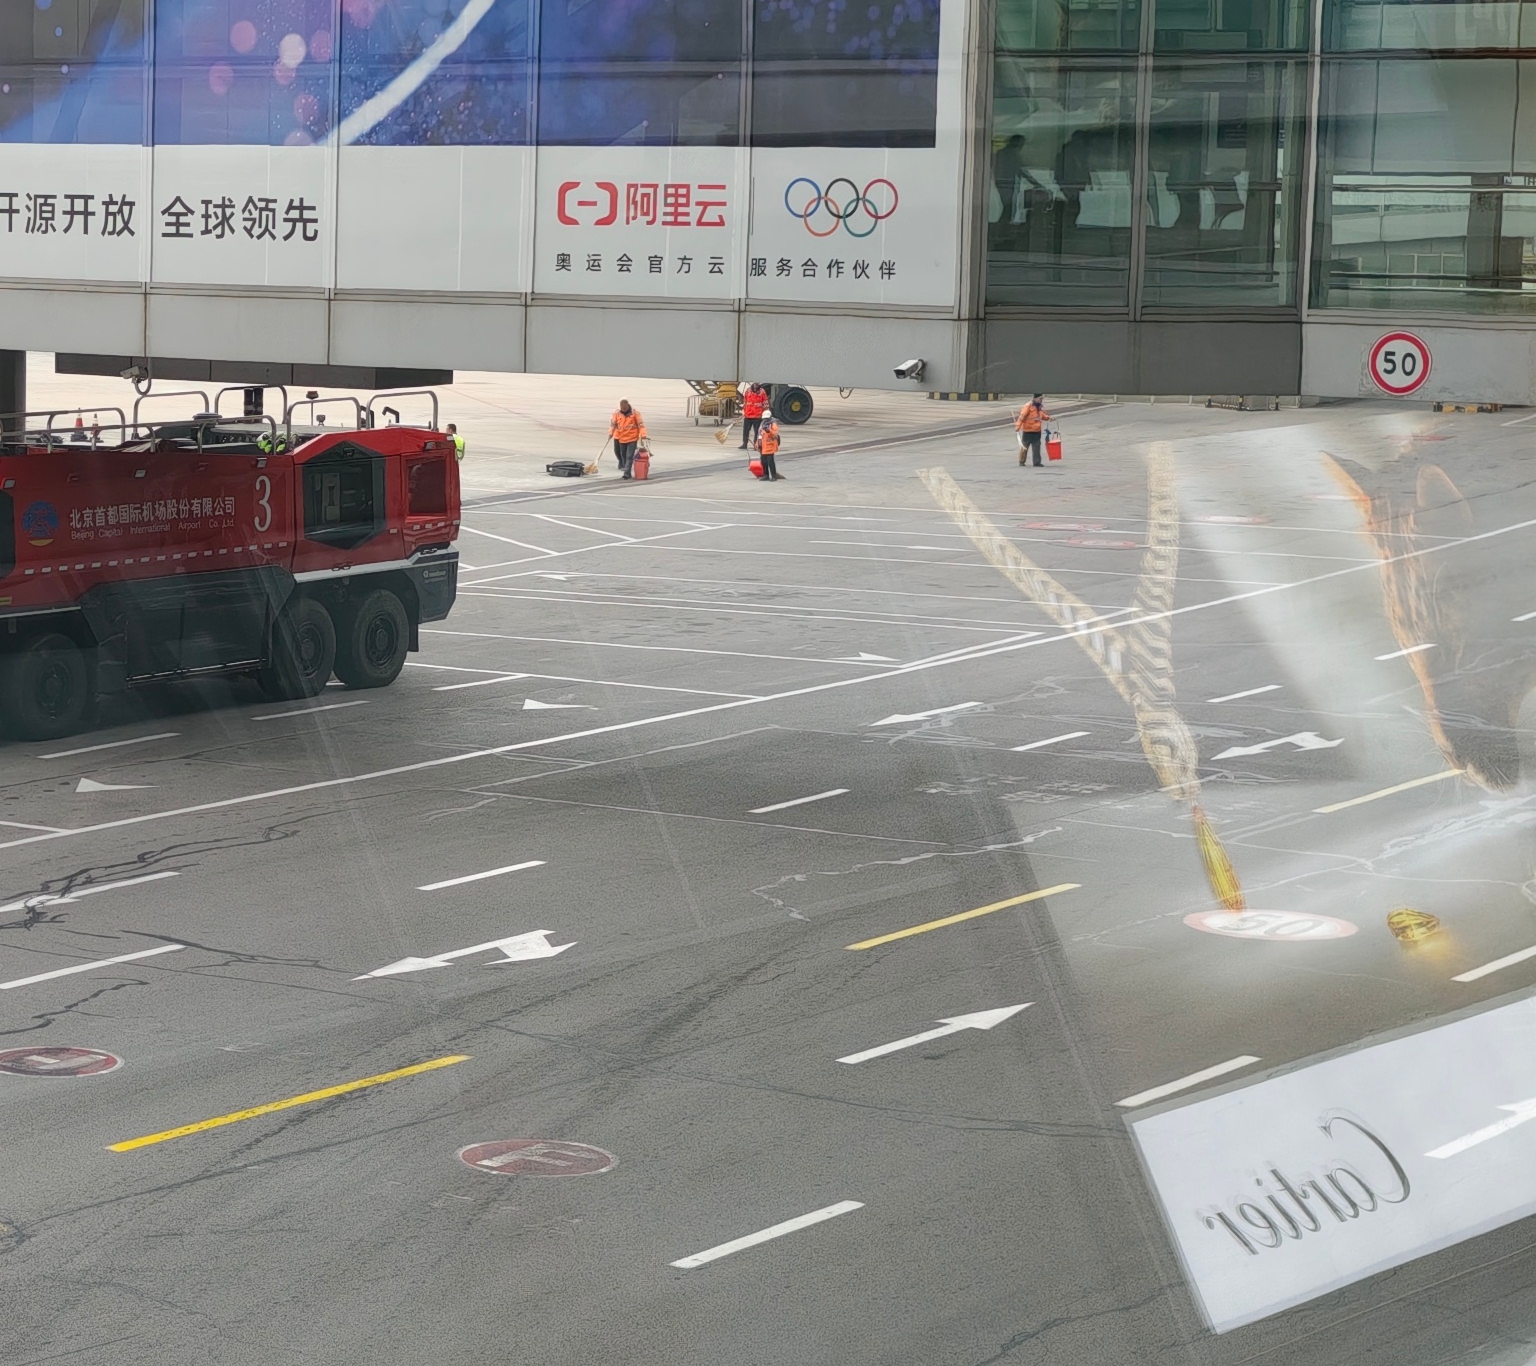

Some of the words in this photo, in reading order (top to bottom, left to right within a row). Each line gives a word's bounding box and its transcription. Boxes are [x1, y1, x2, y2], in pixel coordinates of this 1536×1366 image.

[160, 195, 321, 242] 全球领先
[625, 182, 728, 228] 阿里云
[1382, 350, 1417, 377] 50
[69, 496, 235, 529] 北京首都国际机场股份有限公司
[254, 475, 272, 532] 3
[71, 529, 94, 541] Beijing
[98, 527, 124, 540] Capital
[129, 522, 171, 535] International
[178, 520, 202, 531] Airport
[1216, 913, 1327, 937] 50
